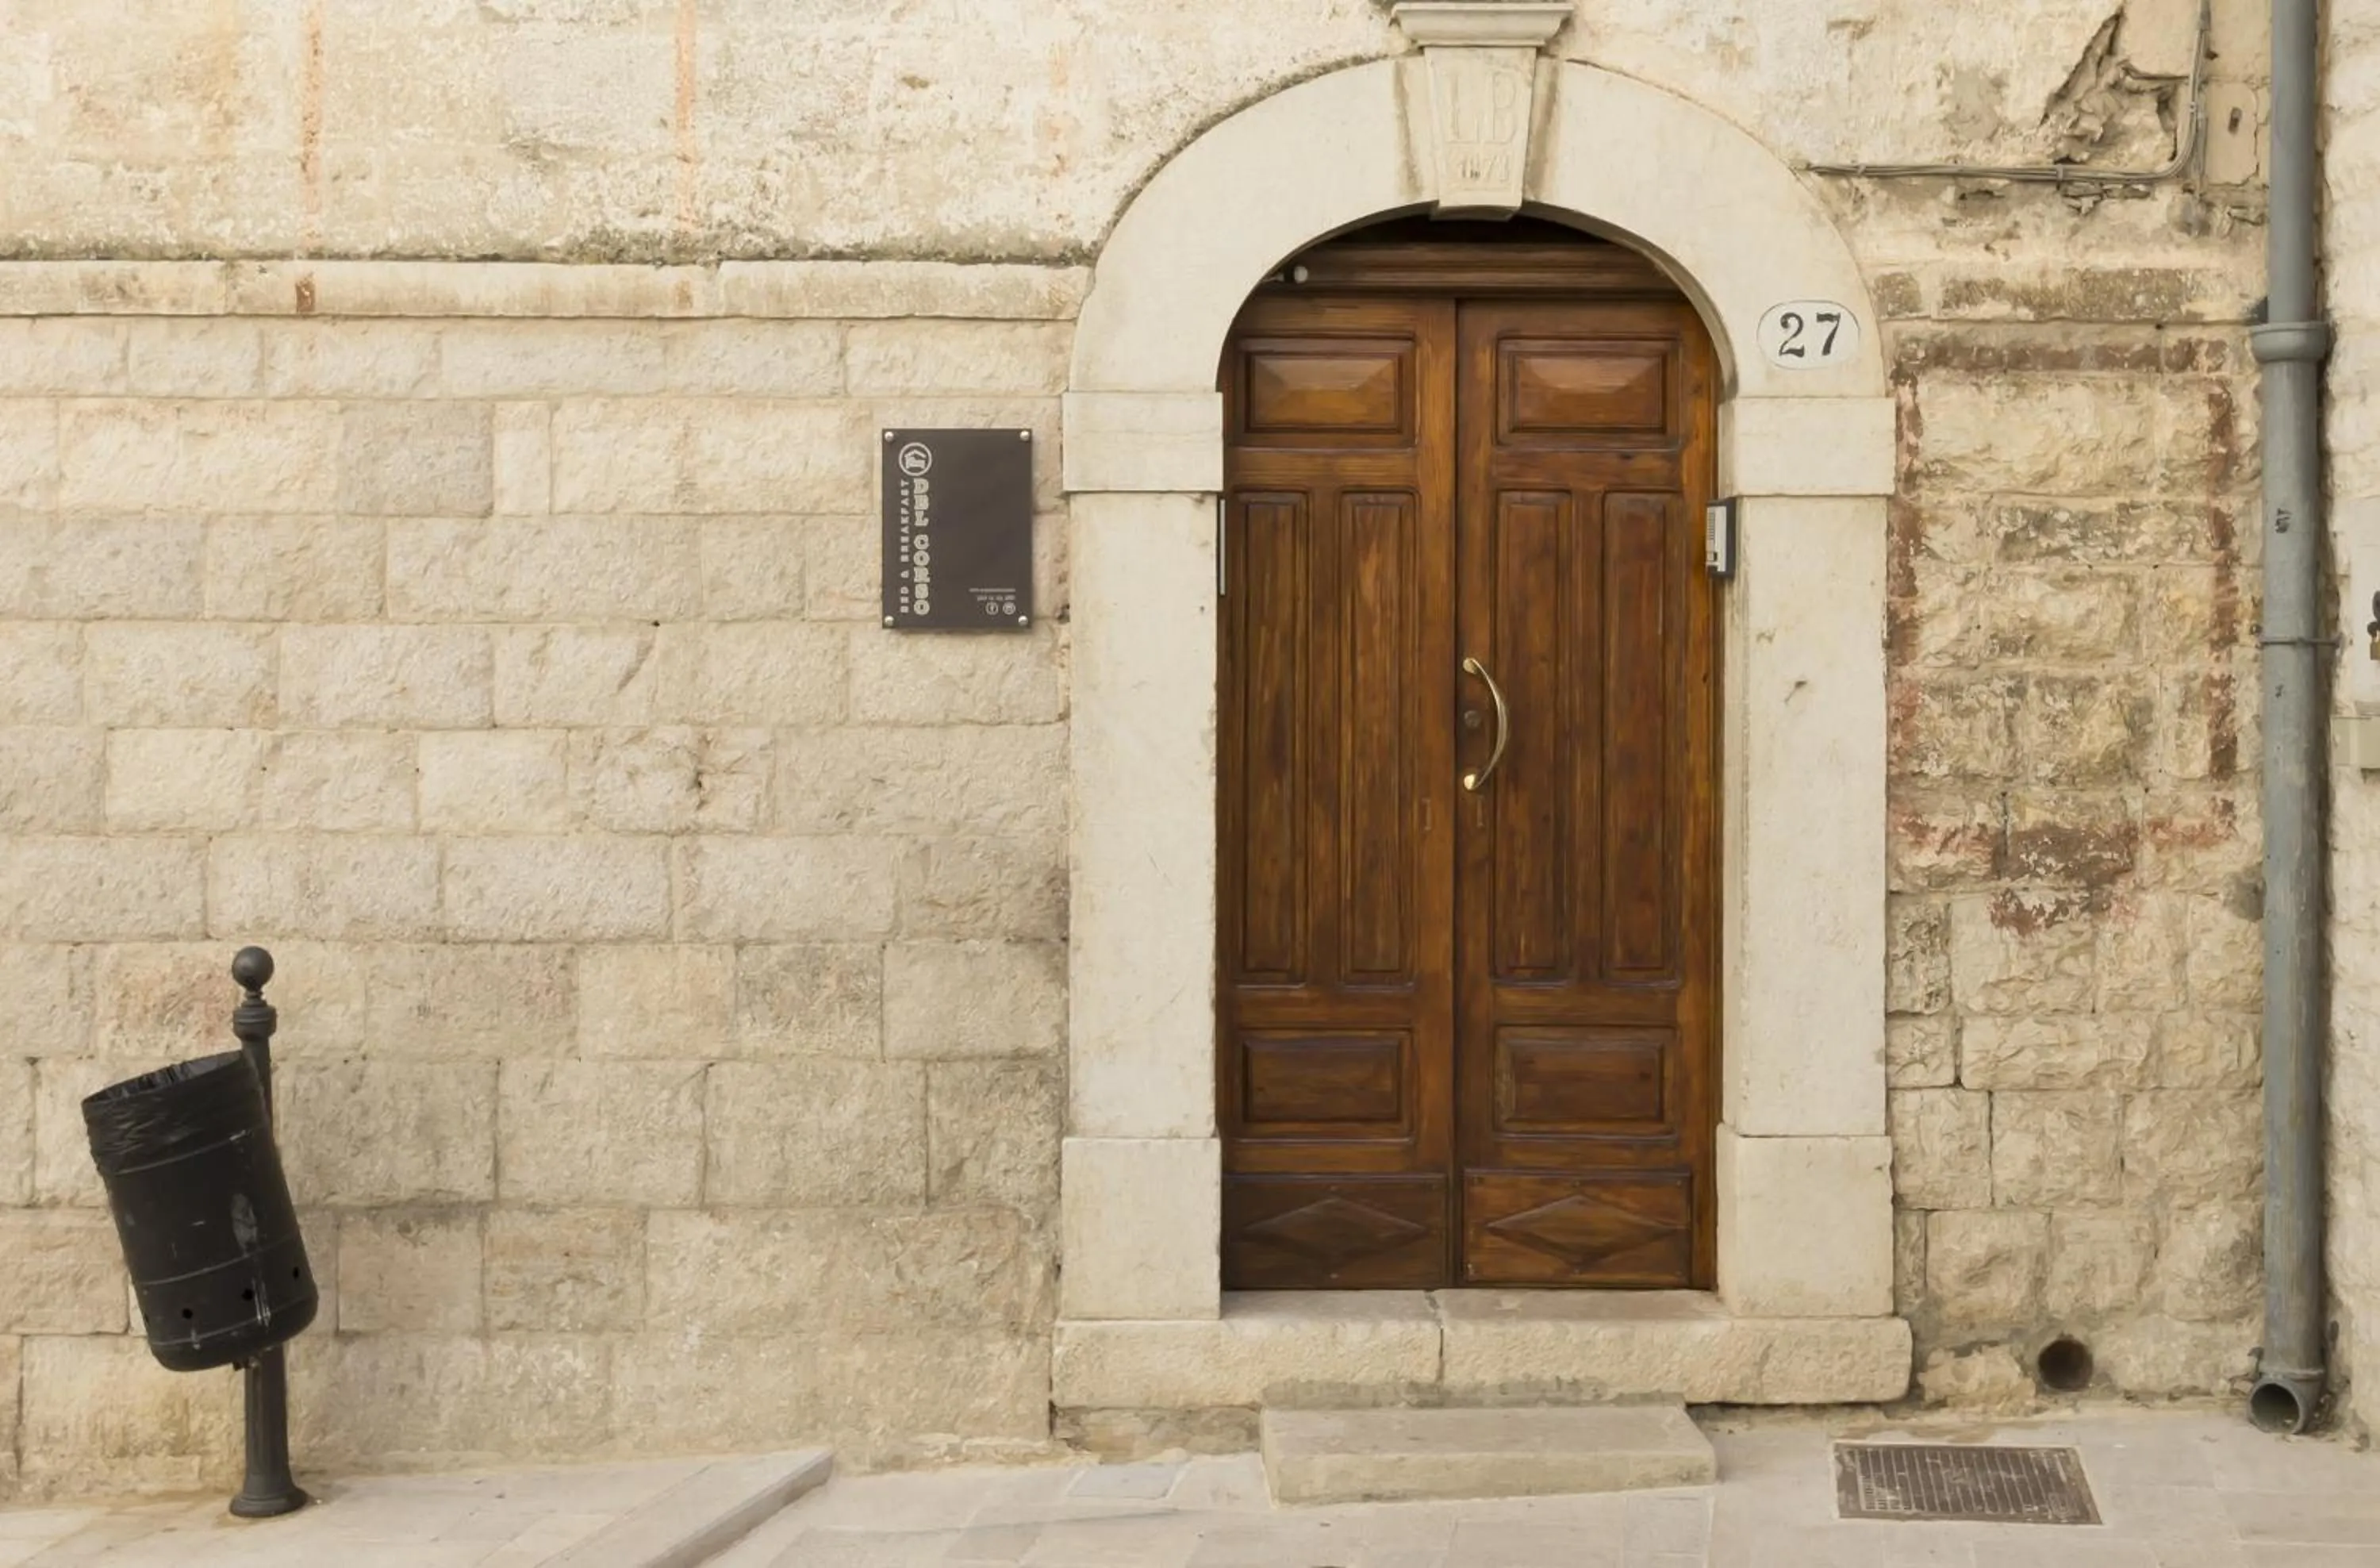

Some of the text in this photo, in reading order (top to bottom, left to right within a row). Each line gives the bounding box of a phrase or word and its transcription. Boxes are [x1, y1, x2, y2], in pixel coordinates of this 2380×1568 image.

[1779, 312, 1841, 358] 27
[900, 479, 909, 563] BREAKFAST
[913, 478, 930, 616] DEL CORSO
[900, 586, 909, 613] BED
